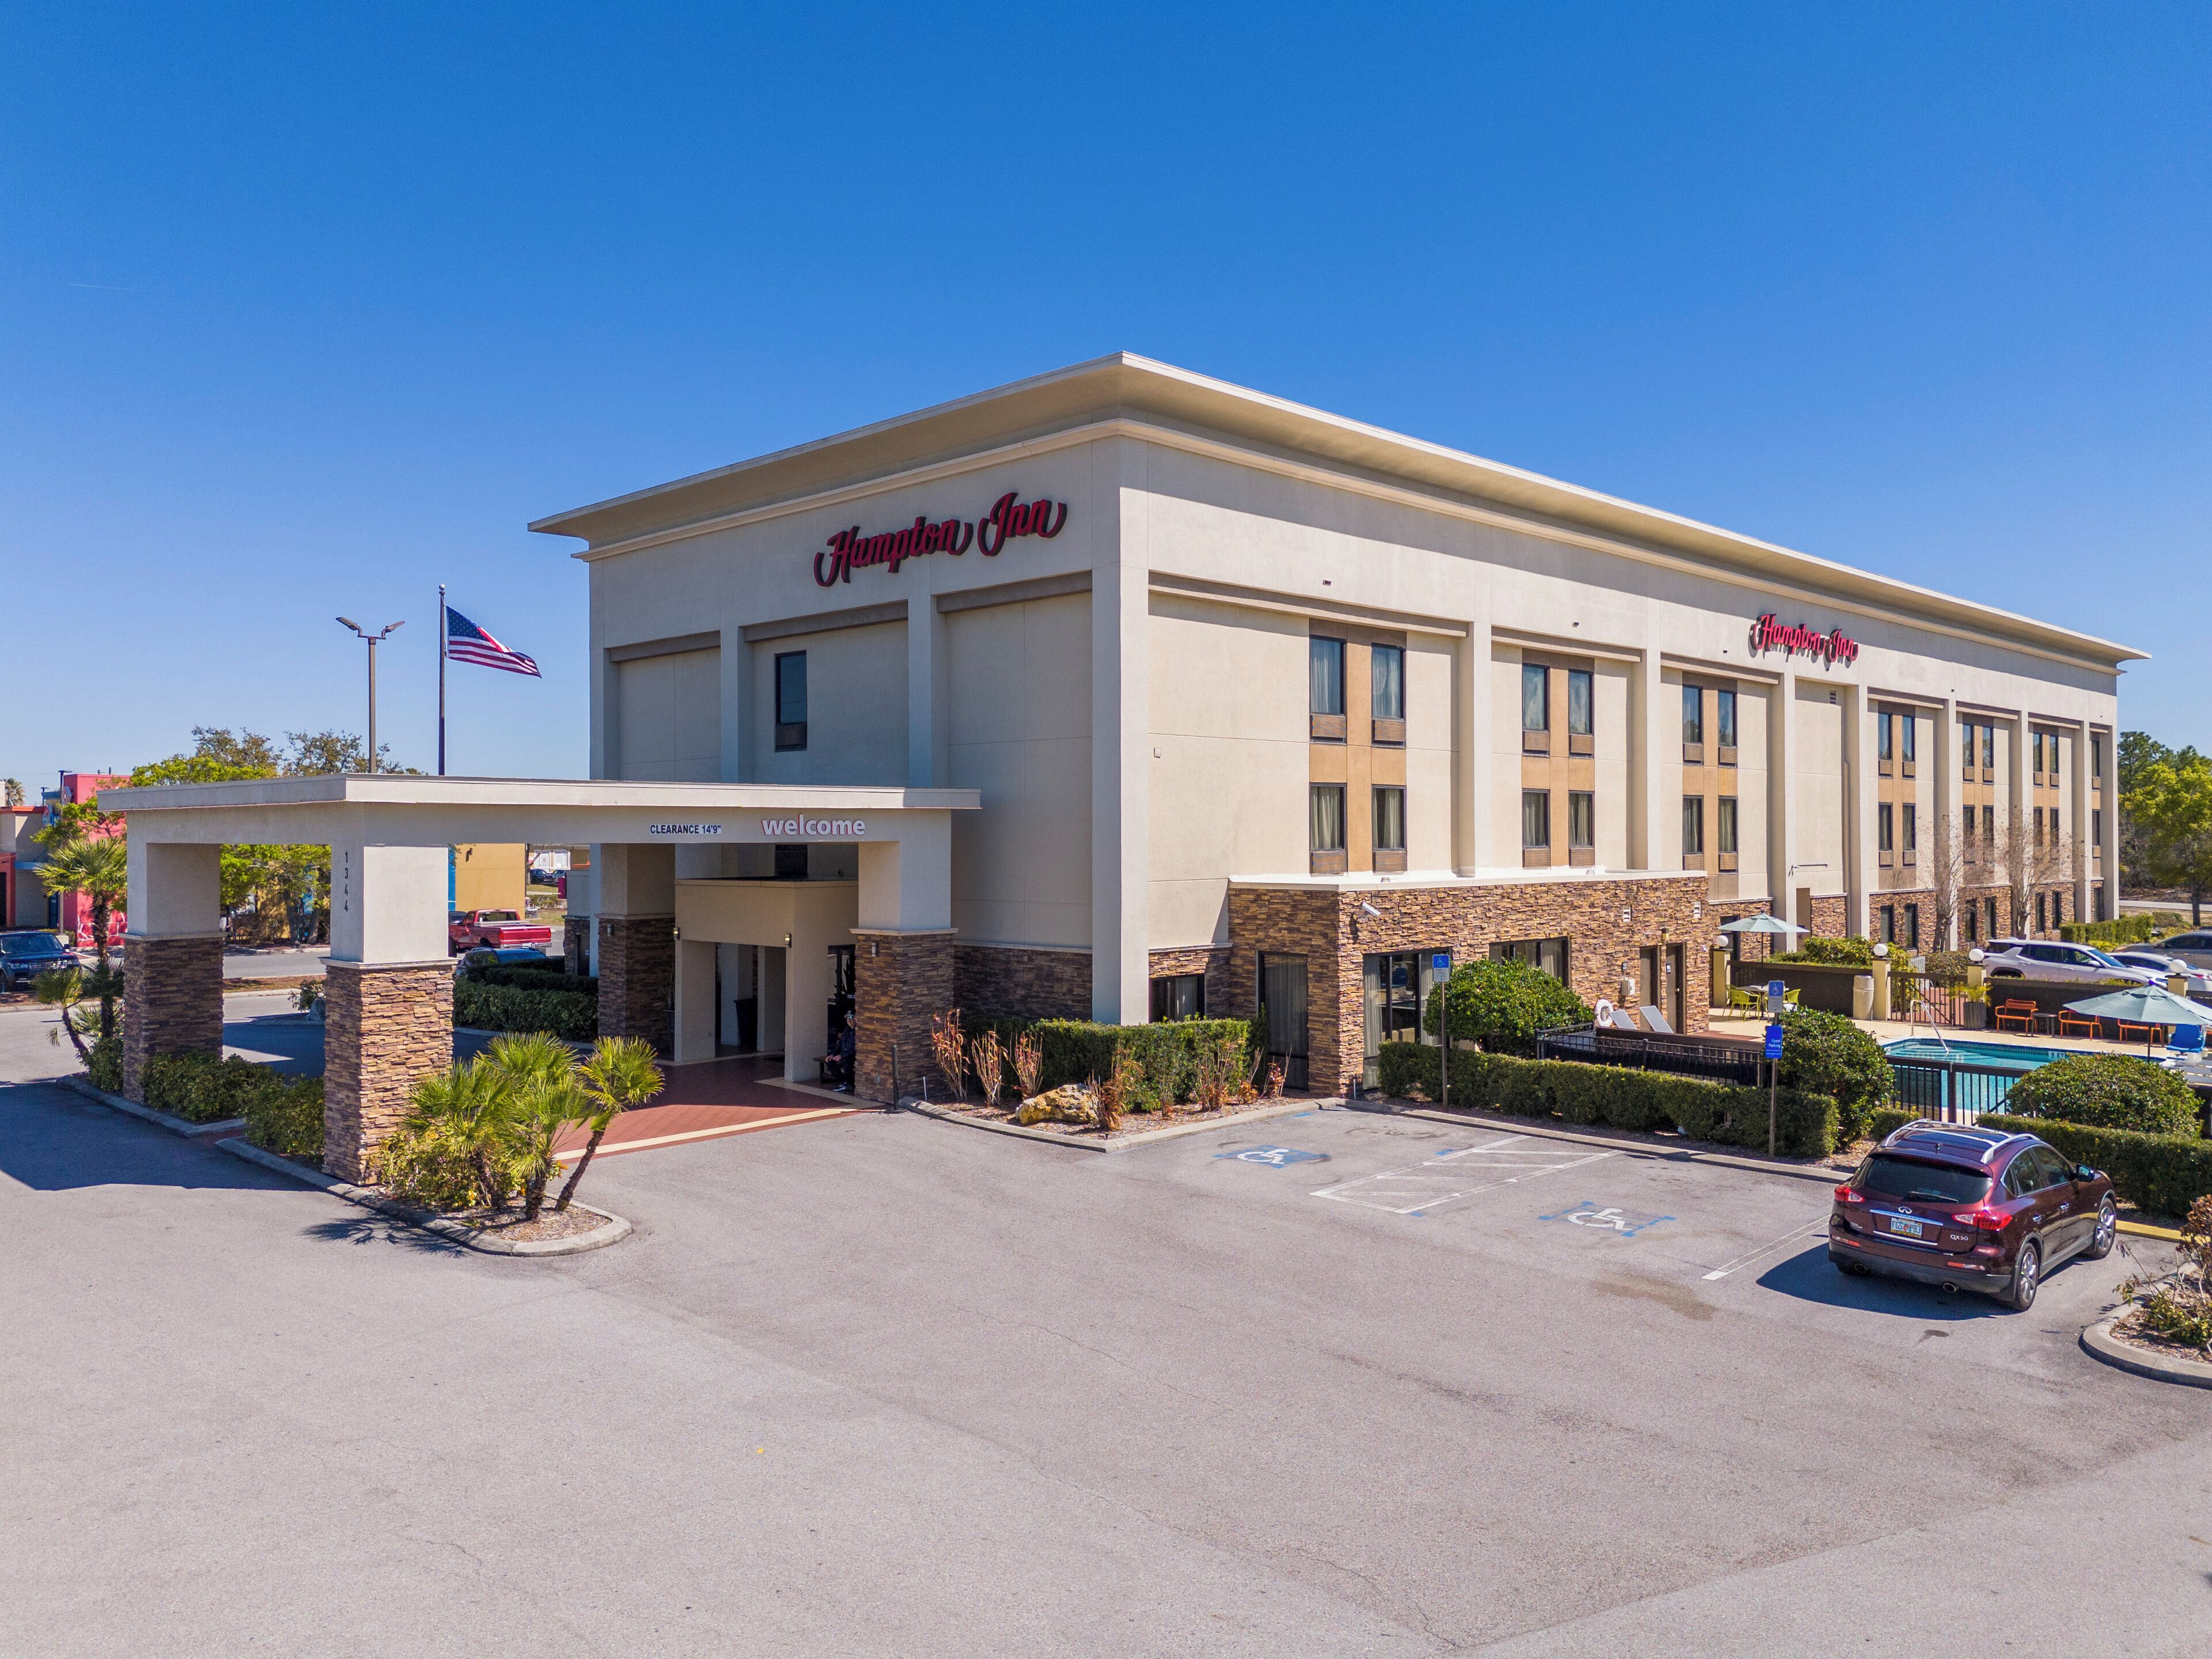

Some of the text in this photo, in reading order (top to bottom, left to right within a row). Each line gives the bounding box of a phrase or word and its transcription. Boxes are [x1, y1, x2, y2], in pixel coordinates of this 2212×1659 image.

[813, 492, 1067, 588] Hampton Inn
[1749, 613, 1859, 663] Hampton Inn
[650, 824, 721, 834] CLEARANCE 14'9"
[761, 813, 865, 835] welcome
